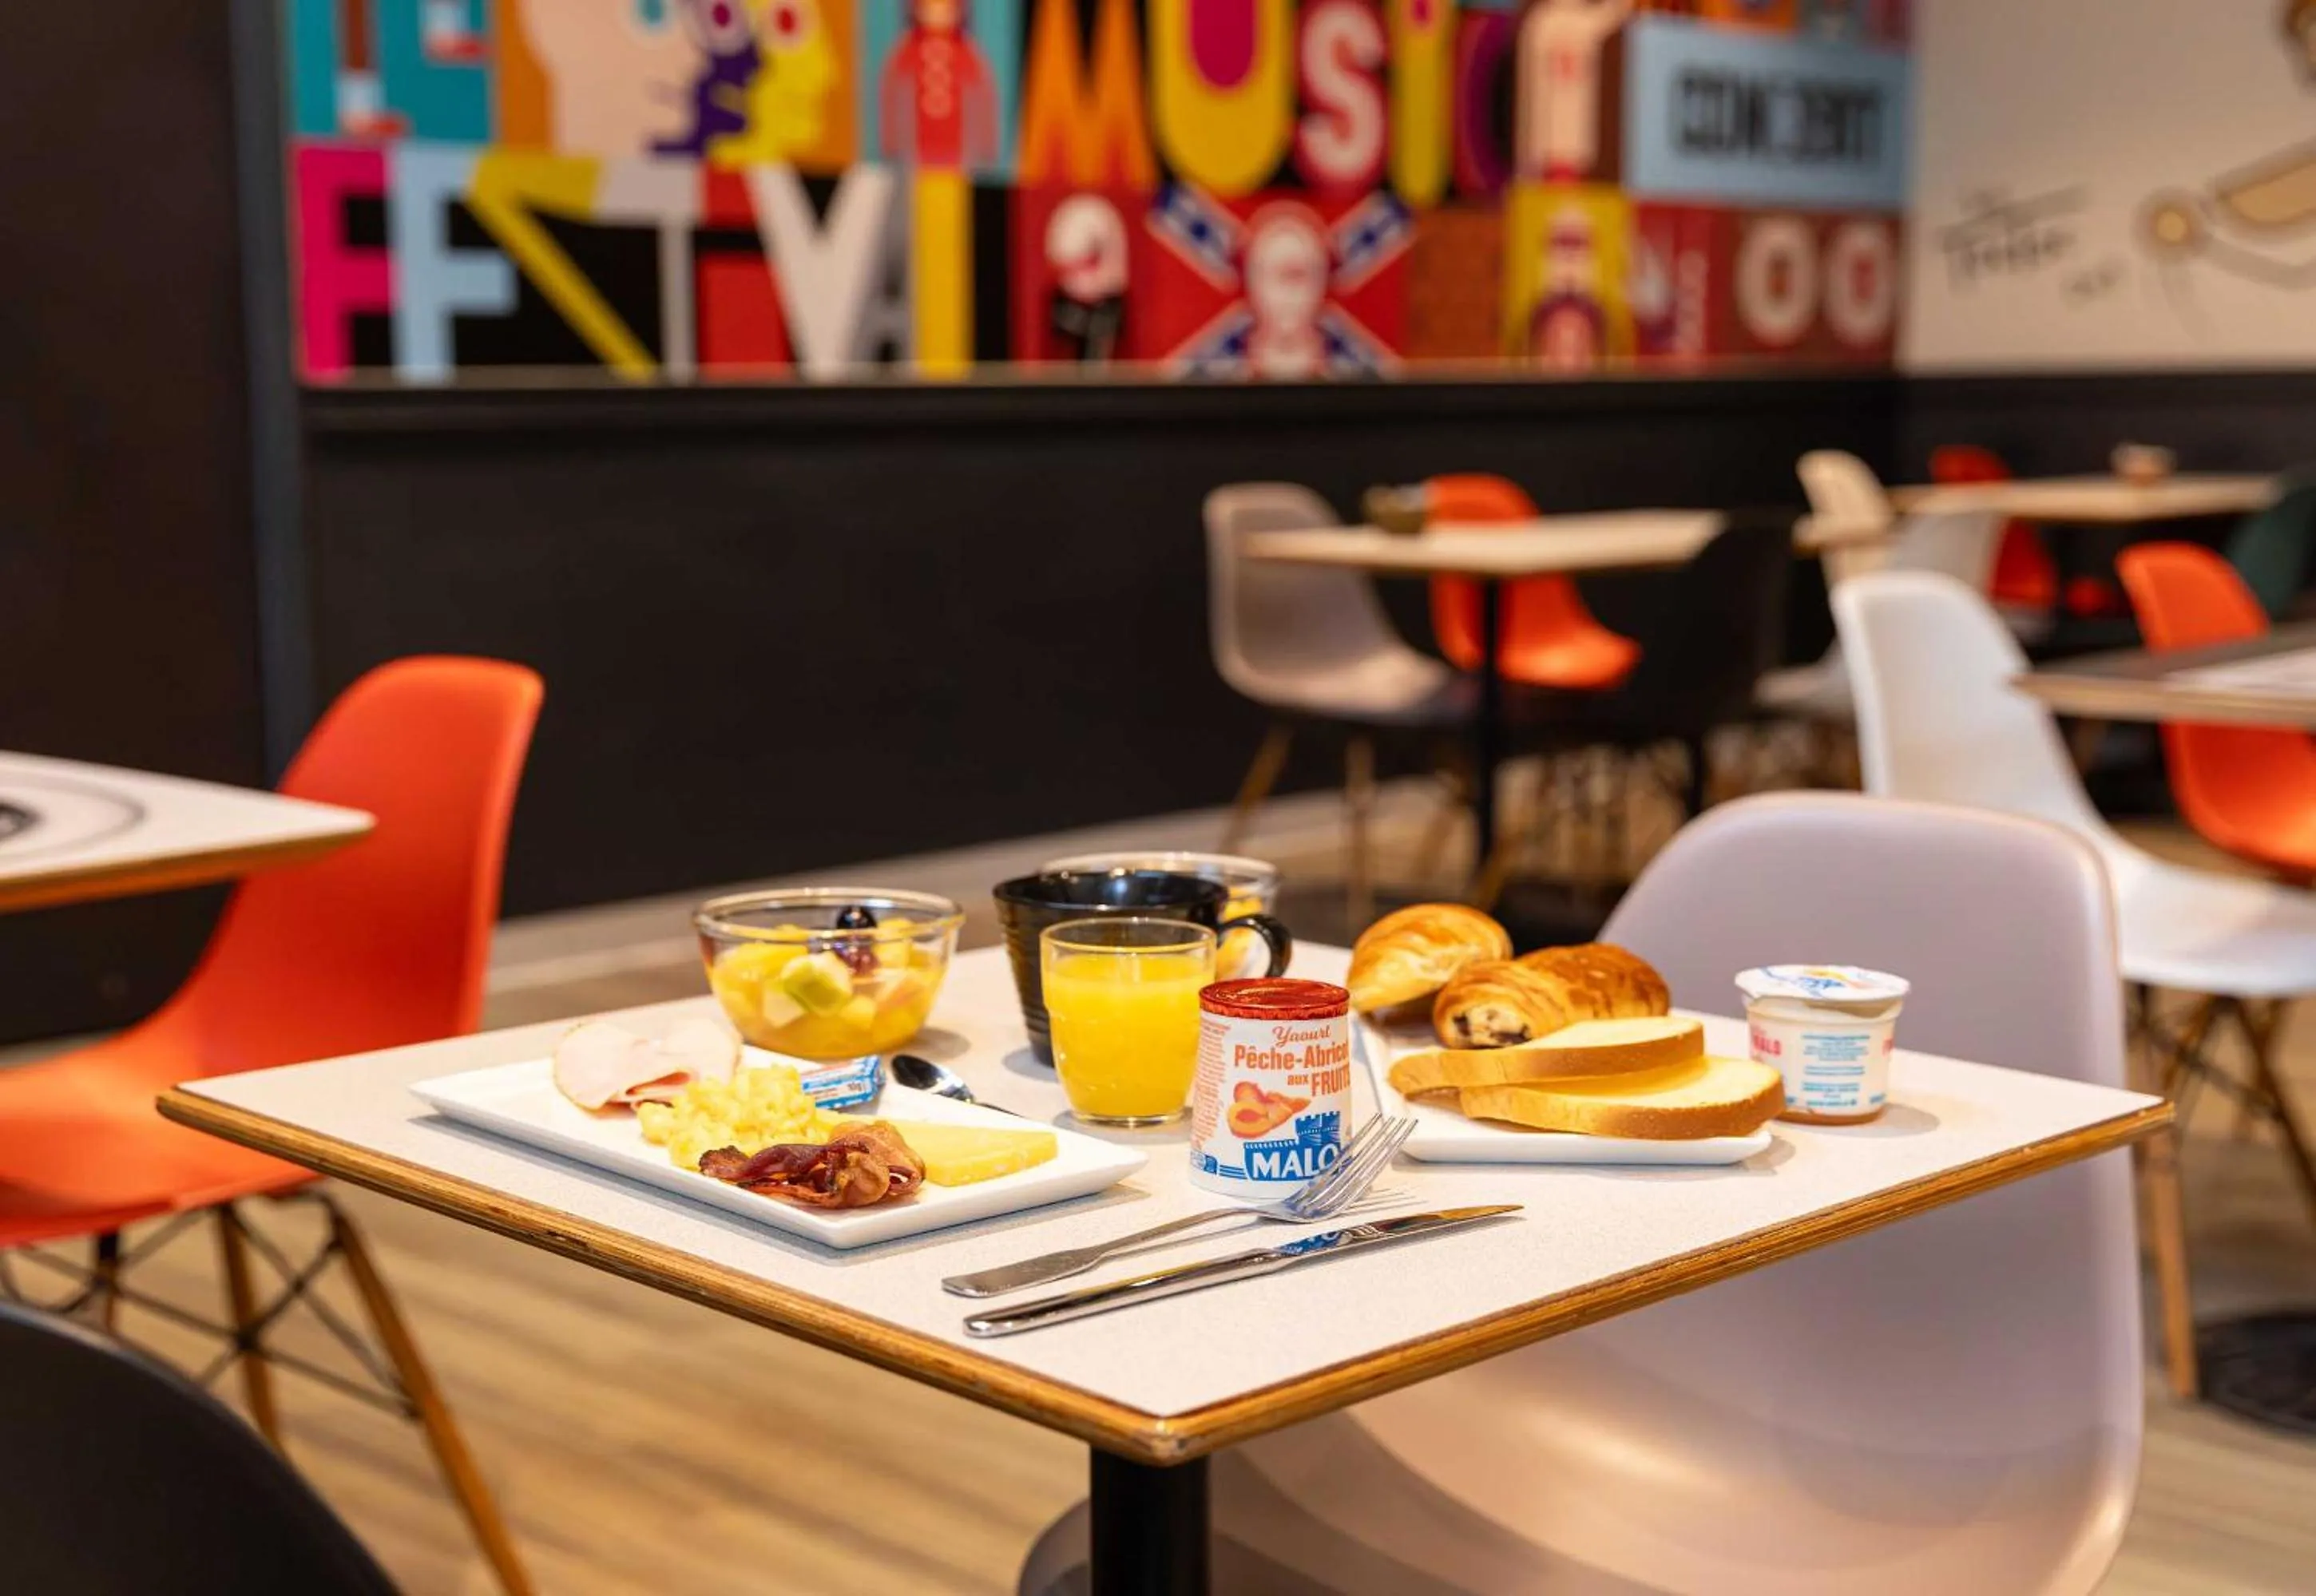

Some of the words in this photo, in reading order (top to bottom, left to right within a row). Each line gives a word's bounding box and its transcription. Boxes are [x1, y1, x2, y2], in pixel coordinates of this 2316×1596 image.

[1272, 1024, 1331, 1047] Yaourt
[1235, 1042, 1348, 1070] Pêche-Abrico
[1287, 1075, 1309, 1085] aux
[1252, 1143, 1338, 1178] MALO
